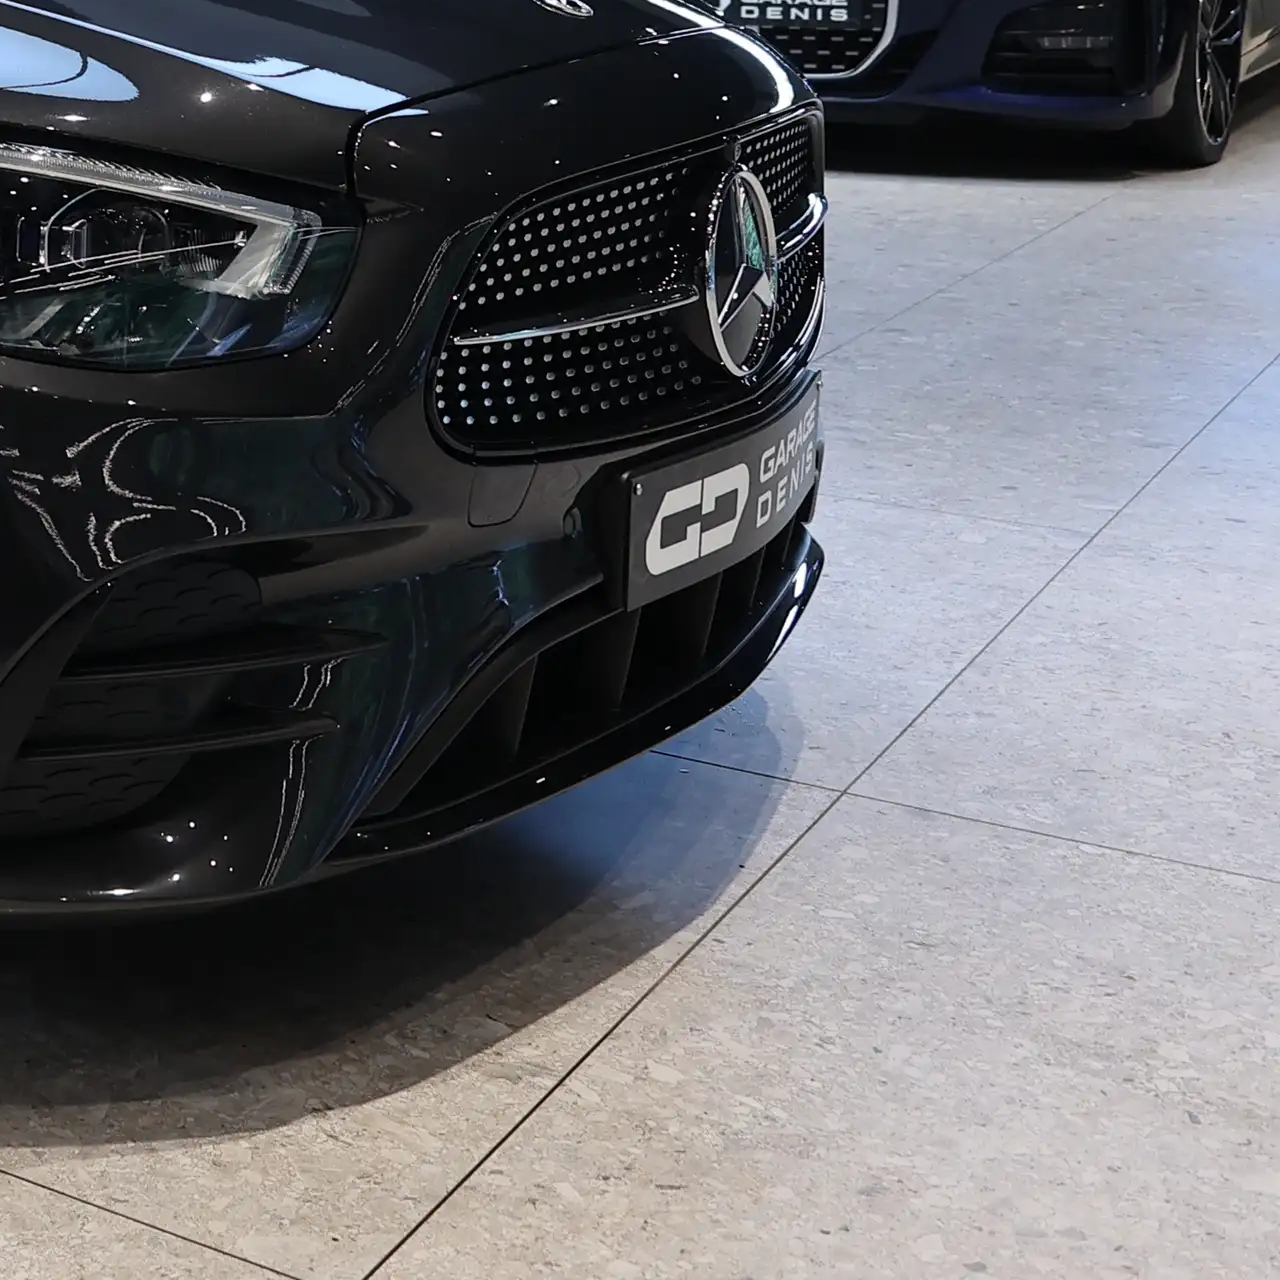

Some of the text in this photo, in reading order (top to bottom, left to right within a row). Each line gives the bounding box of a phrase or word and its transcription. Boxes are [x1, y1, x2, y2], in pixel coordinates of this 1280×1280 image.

[740, 5, 849, 22] DENIS
[759, 399, 817, 484] GARAGE
[756, 440, 814, 529] DENIS
